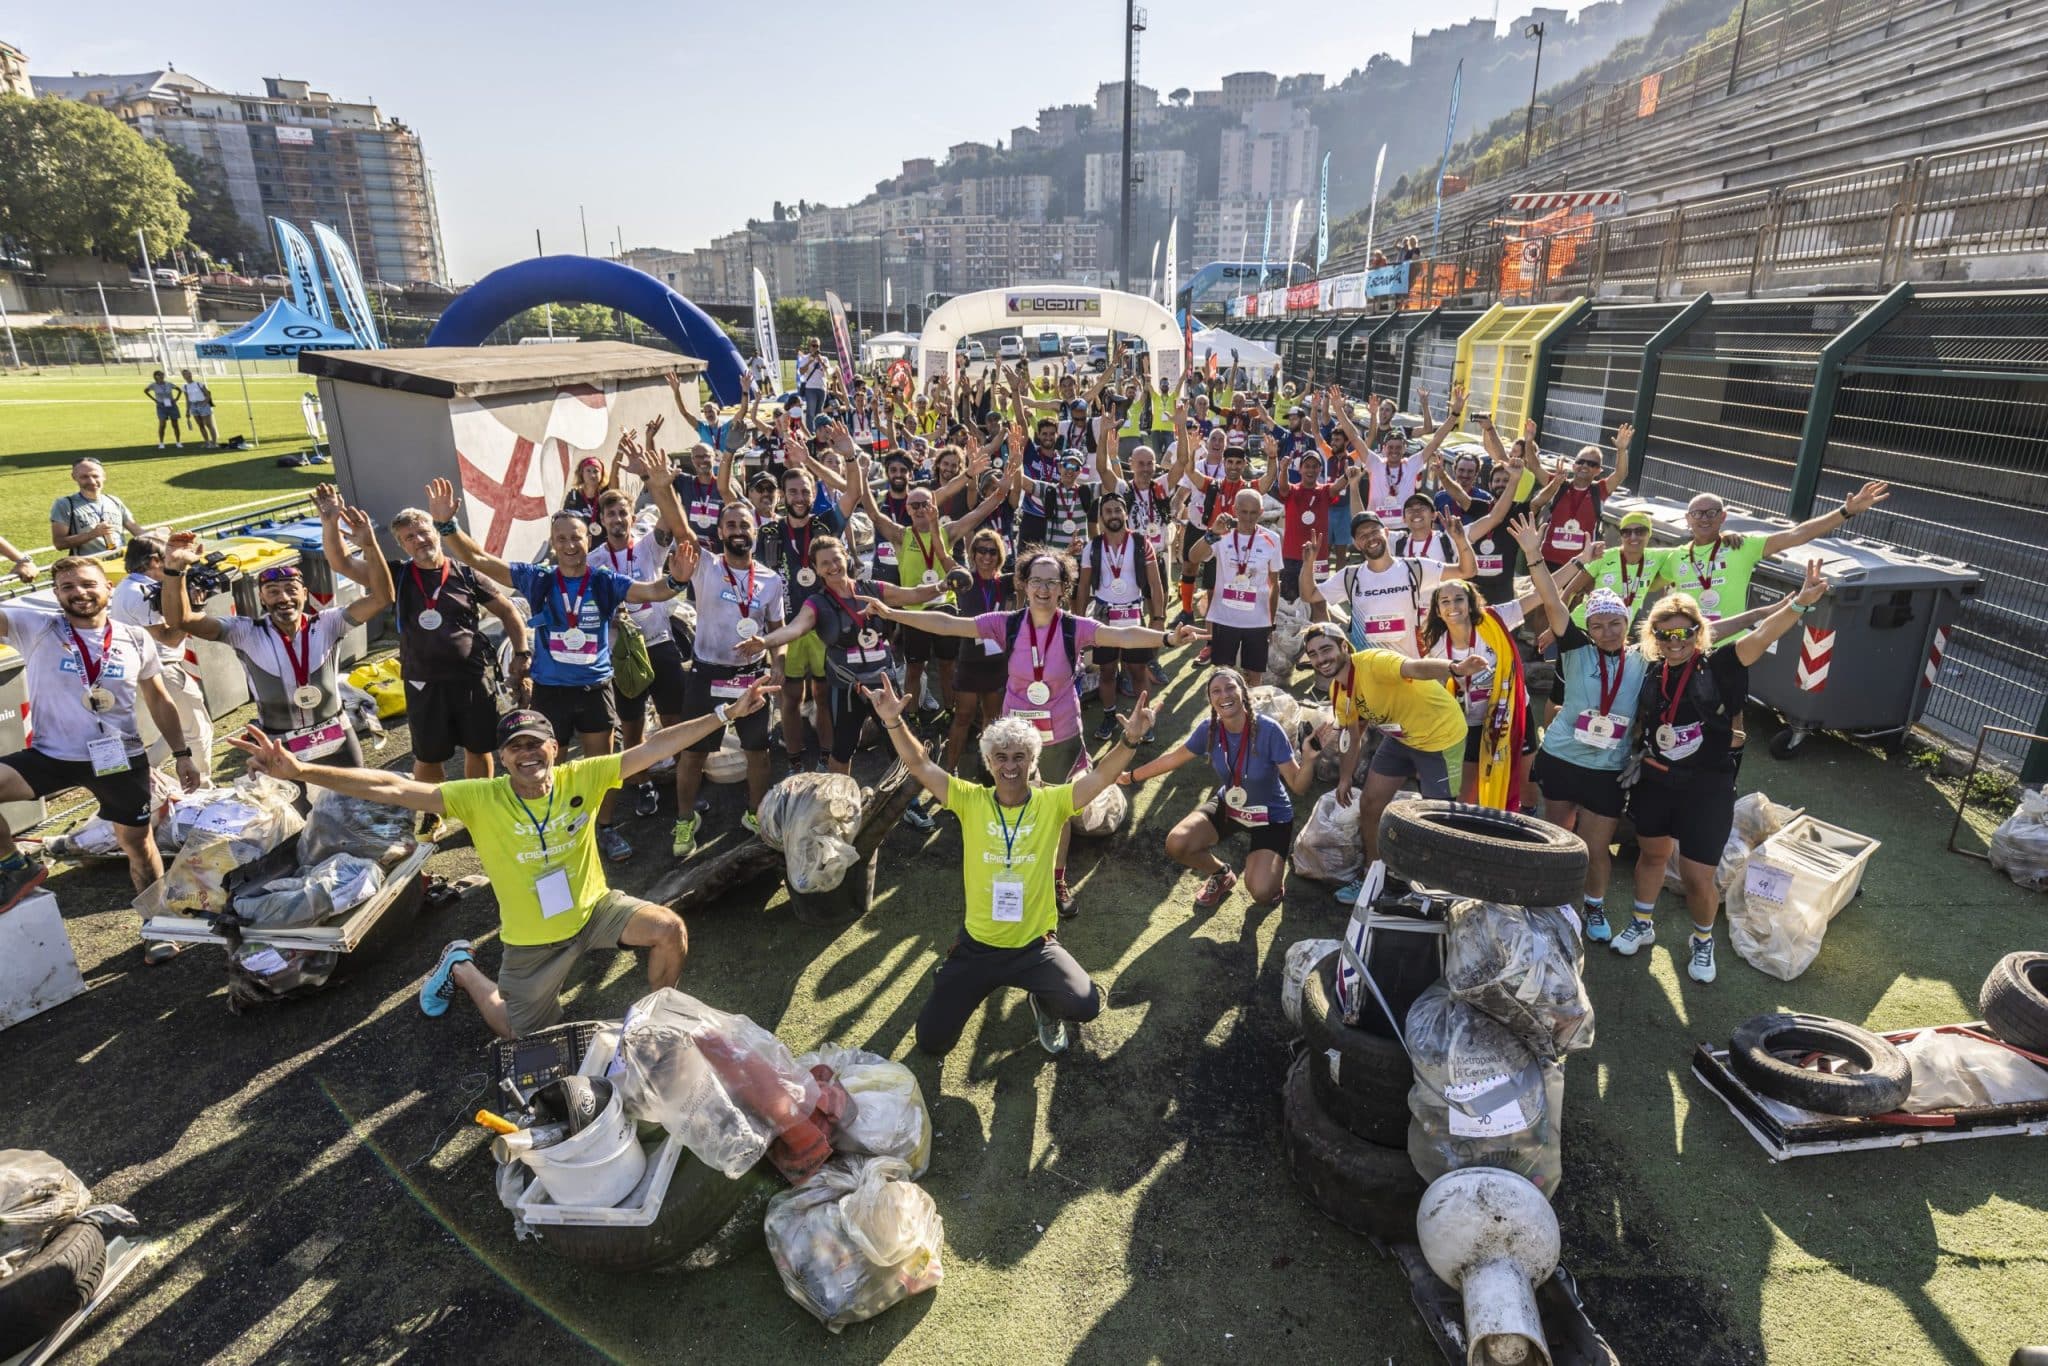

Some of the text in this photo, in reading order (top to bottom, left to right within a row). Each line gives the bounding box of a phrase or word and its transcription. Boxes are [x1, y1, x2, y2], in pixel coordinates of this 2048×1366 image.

[1364, 585, 1409, 597] SCARPA
[1378, 621, 1391, 631] 82
[308, 731, 325, 744] 34
